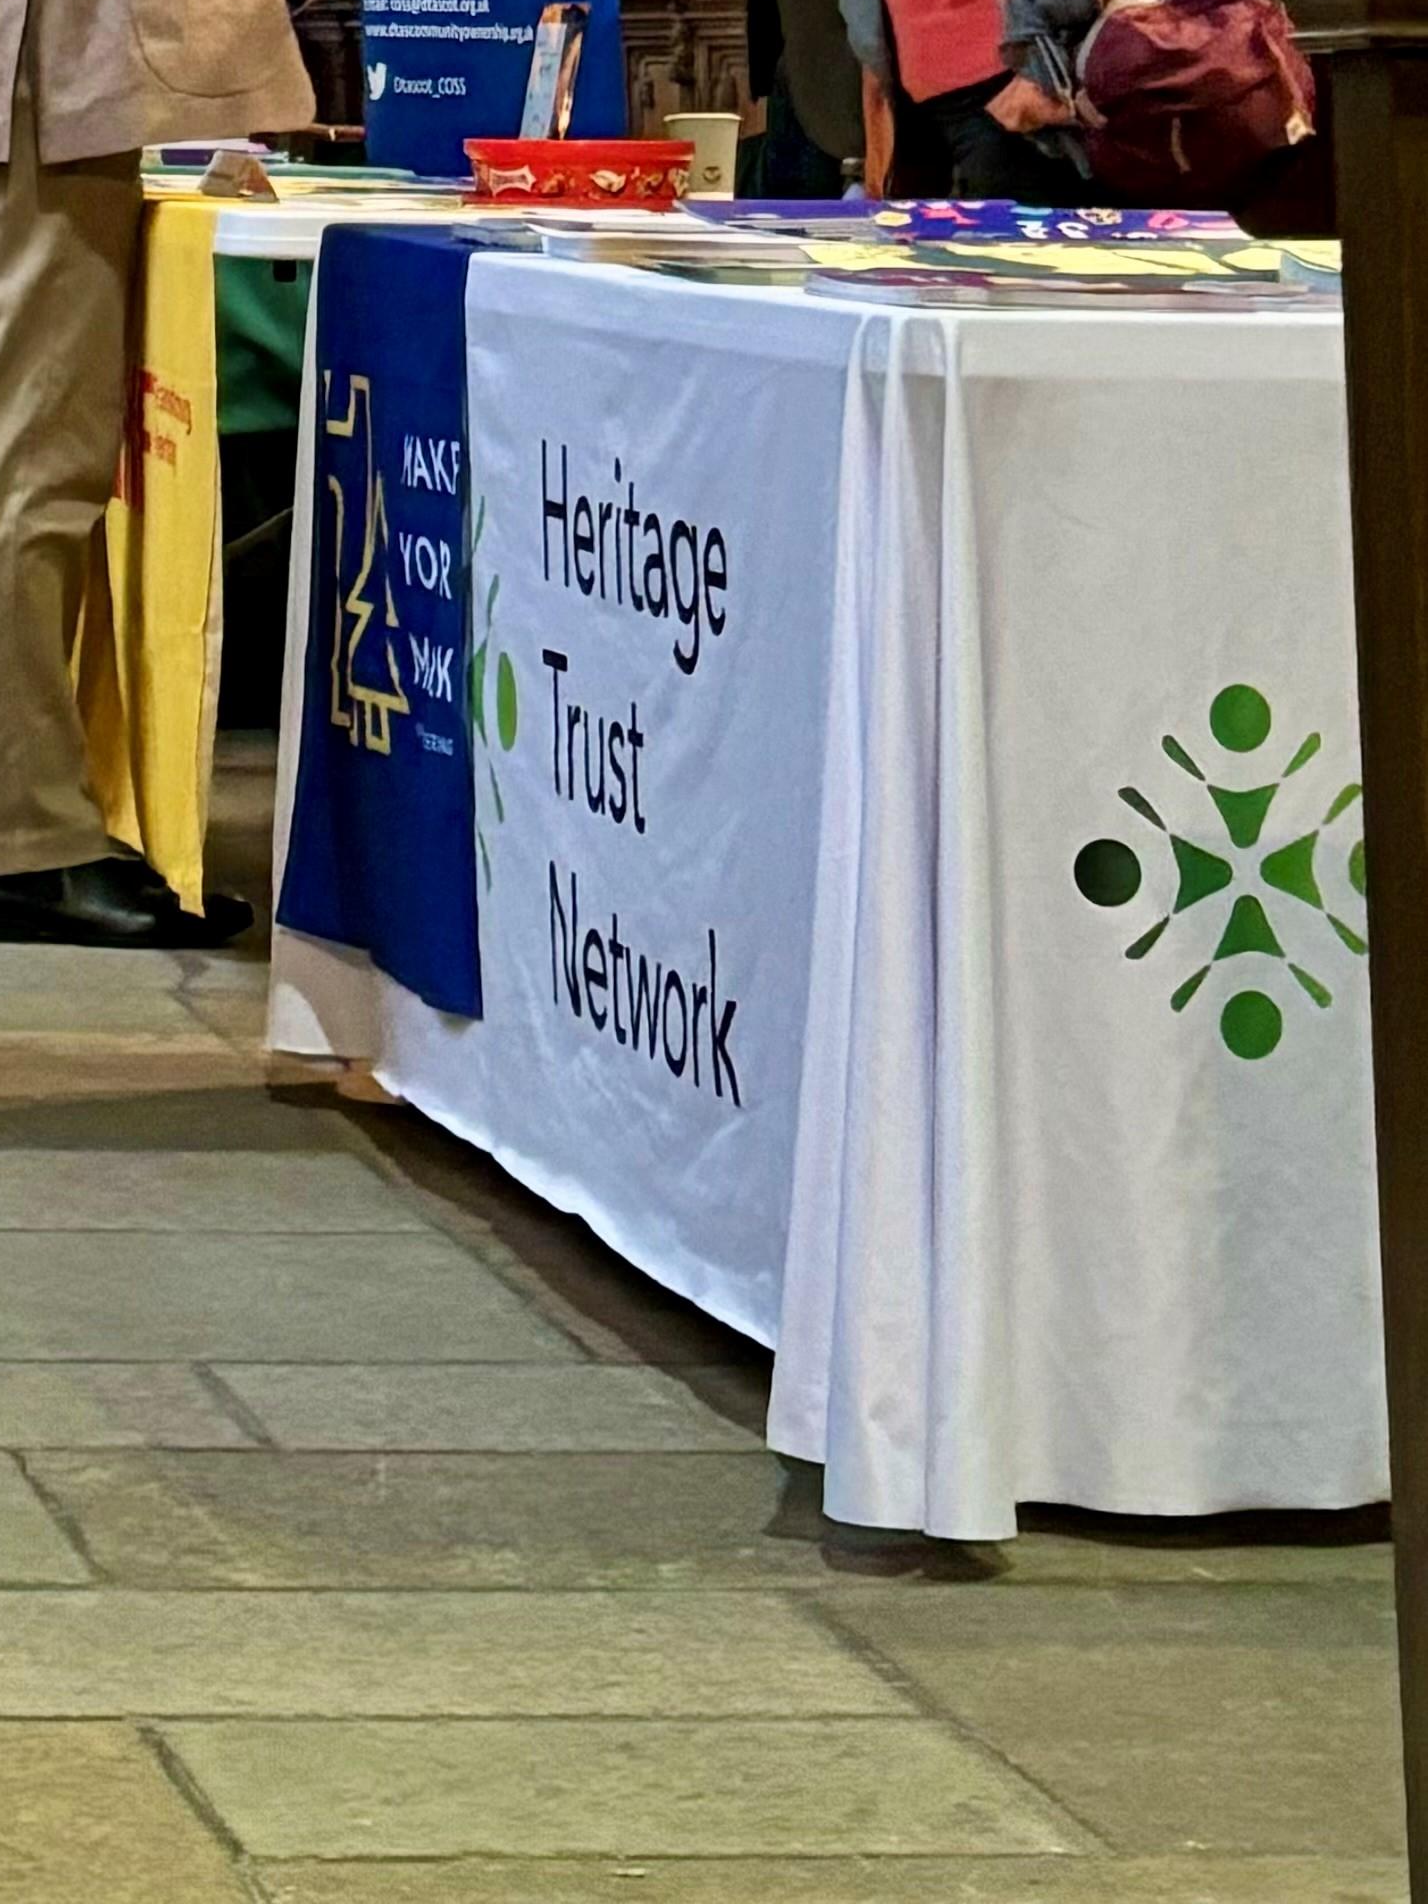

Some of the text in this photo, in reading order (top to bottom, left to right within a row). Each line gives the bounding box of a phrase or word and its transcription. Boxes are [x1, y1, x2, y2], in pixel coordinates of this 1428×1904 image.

[541, 439, 727, 675] Heritage
[542, 649, 645, 834] Trust
[549, 861, 741, 1107] Network
